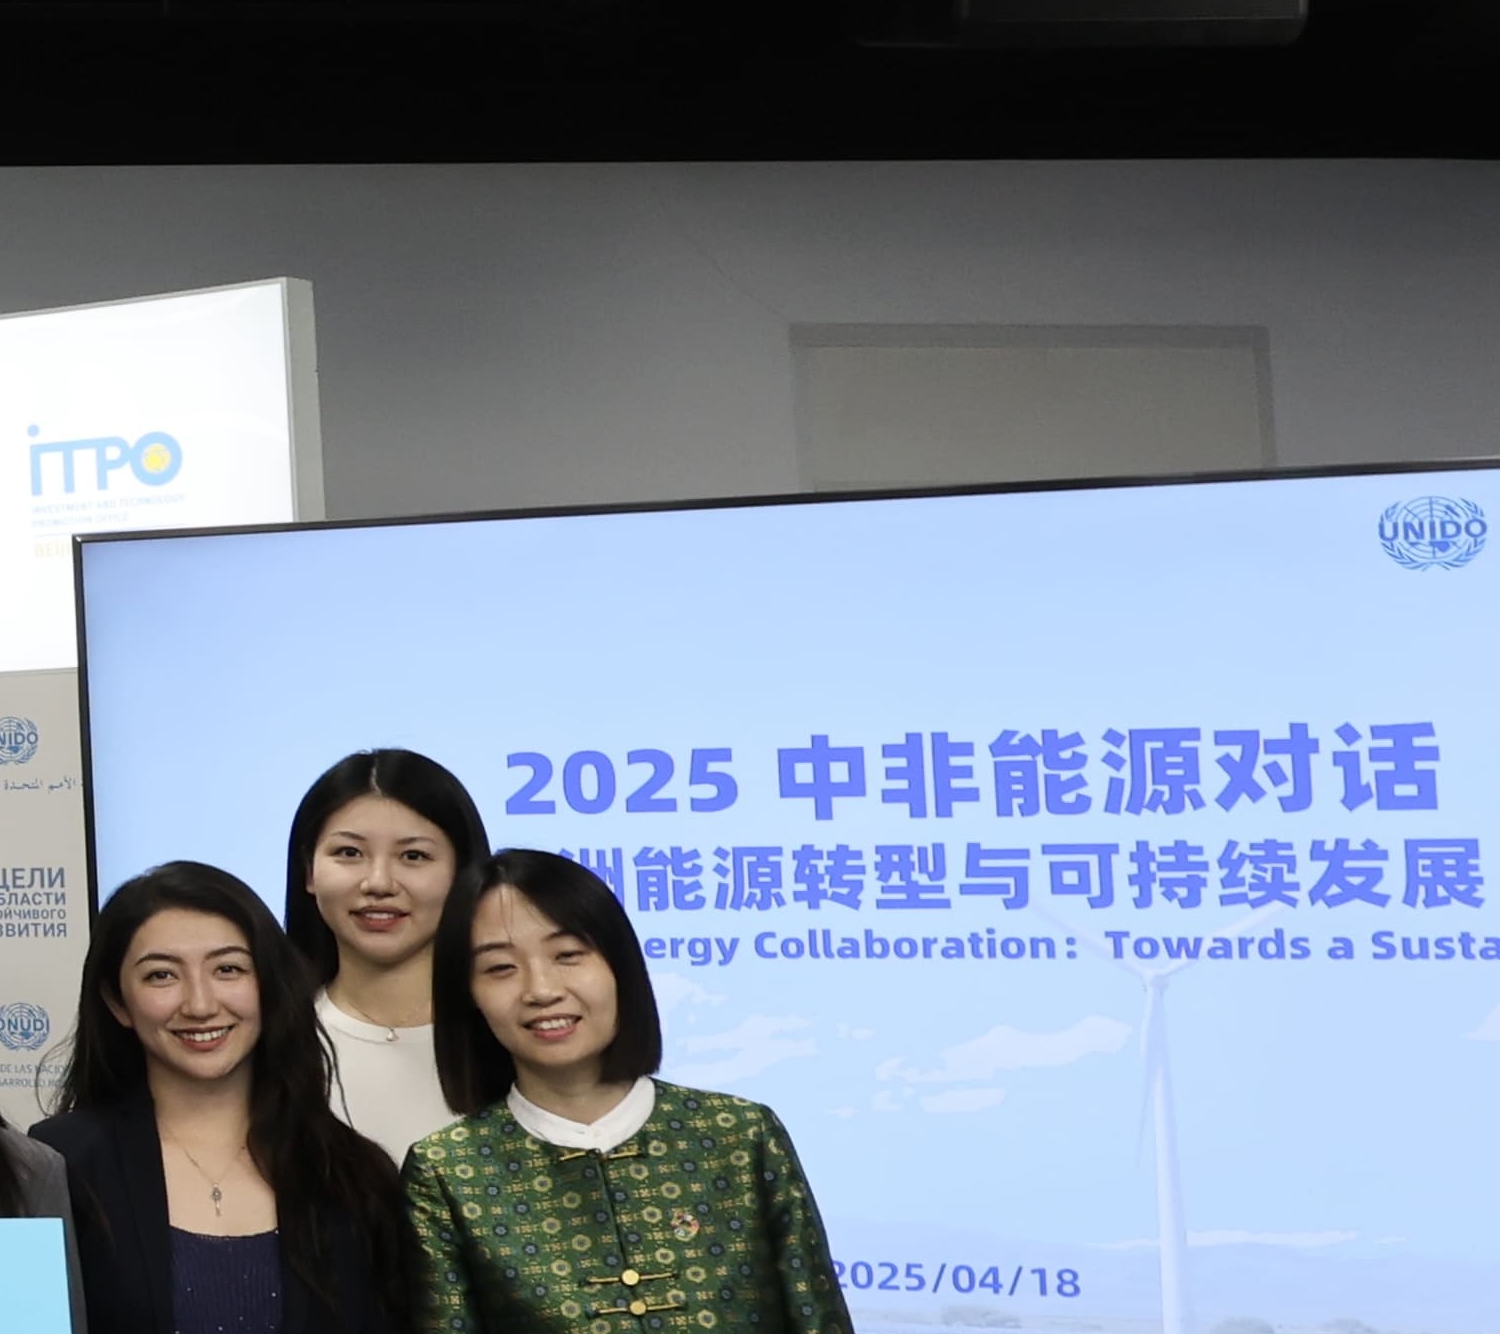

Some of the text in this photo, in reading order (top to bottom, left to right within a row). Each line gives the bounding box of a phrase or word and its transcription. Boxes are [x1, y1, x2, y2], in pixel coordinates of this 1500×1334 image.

[1378, 514, 1488, 545] UNIDO
[506, 722, 1439, 820] 2025 中非能源对话
[644, 935, 741, 967] ergy
[1105, 928, 1311, 959] Towards
[1328, 937, 1354, 959] a
[1372, 931, 1500, 960] Susta
[832, 1261, 1081, 1298] 2025/04/18
